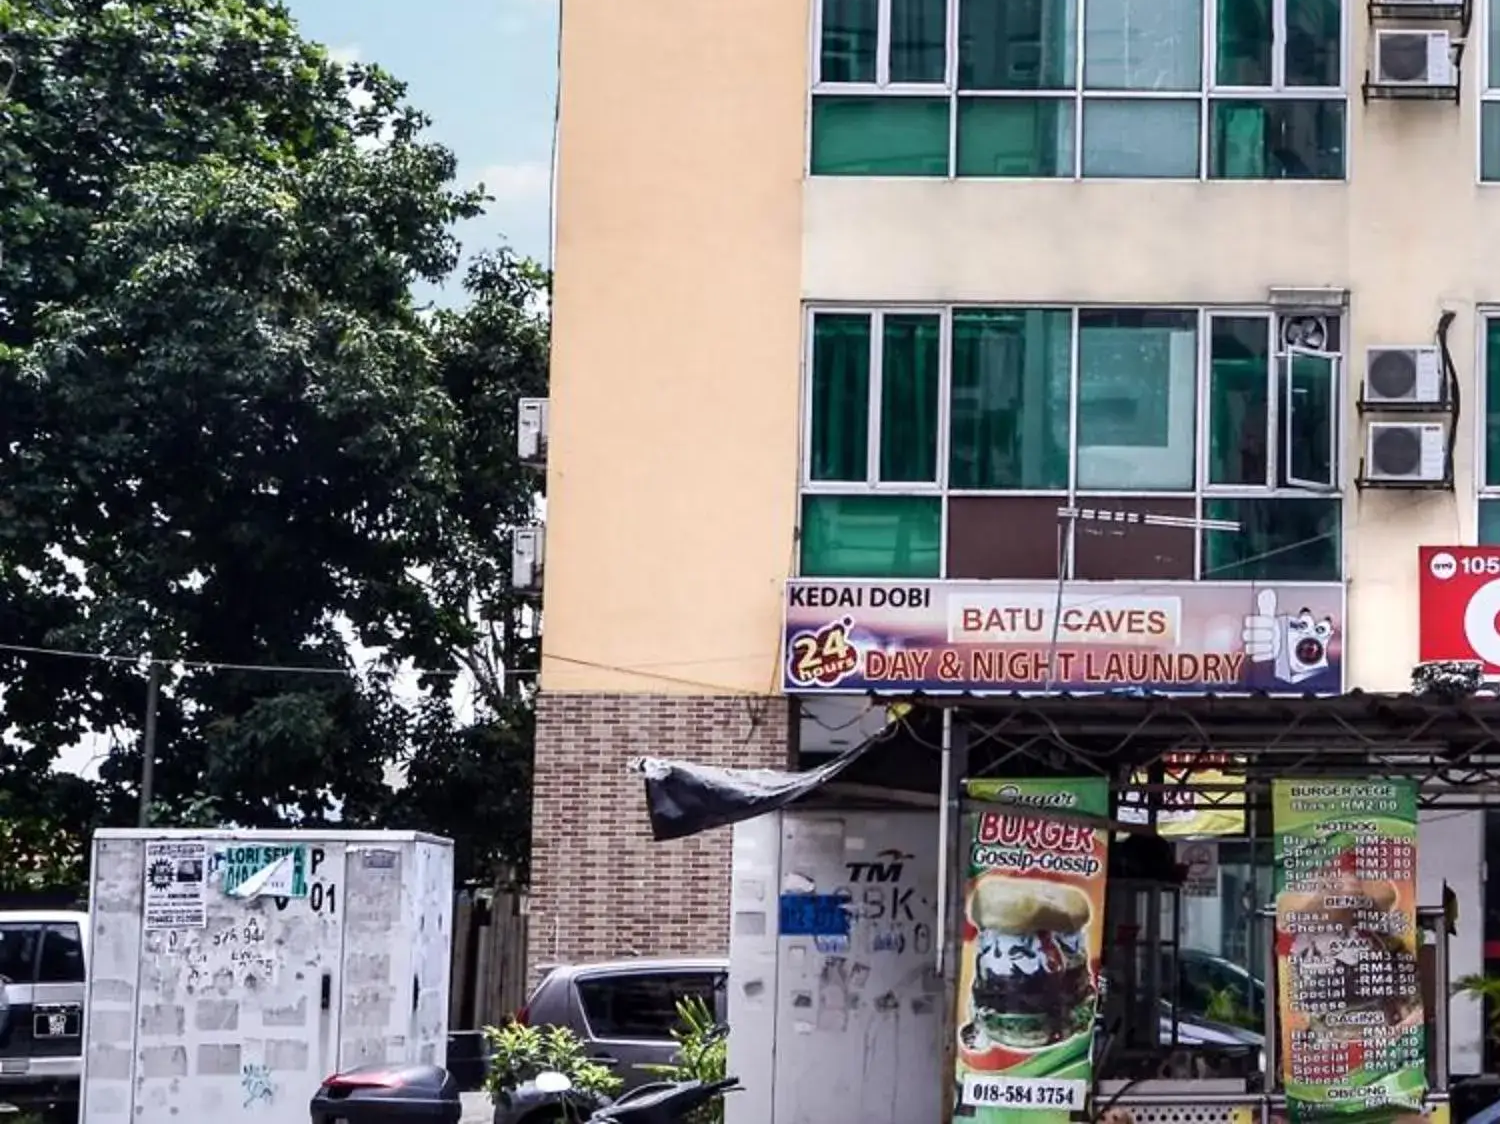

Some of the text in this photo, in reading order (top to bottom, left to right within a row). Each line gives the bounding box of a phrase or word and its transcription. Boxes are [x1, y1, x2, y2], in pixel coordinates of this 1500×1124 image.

[789, 587, 930, 608] KEDAI DOBI
[963, 609, 1166, 635] BATU CAVES
[794, 628, 847, 671] 24
[797, 652, 856, 682] hours
[865, 650, 1244, 684] DAY & NIGHT LAUNDRY
[979, 812, 1096, 852] BURGER
[227, 847, 259, 864] LORI
[311, 848, 325, 874] P
[973, 849, 1099, 875] Gossip-Gossip
[846, 862, 903, 882] TM
[311, 882, 336, 913] 01
[973, 1083, 1074, 1104] 018-584 3754
